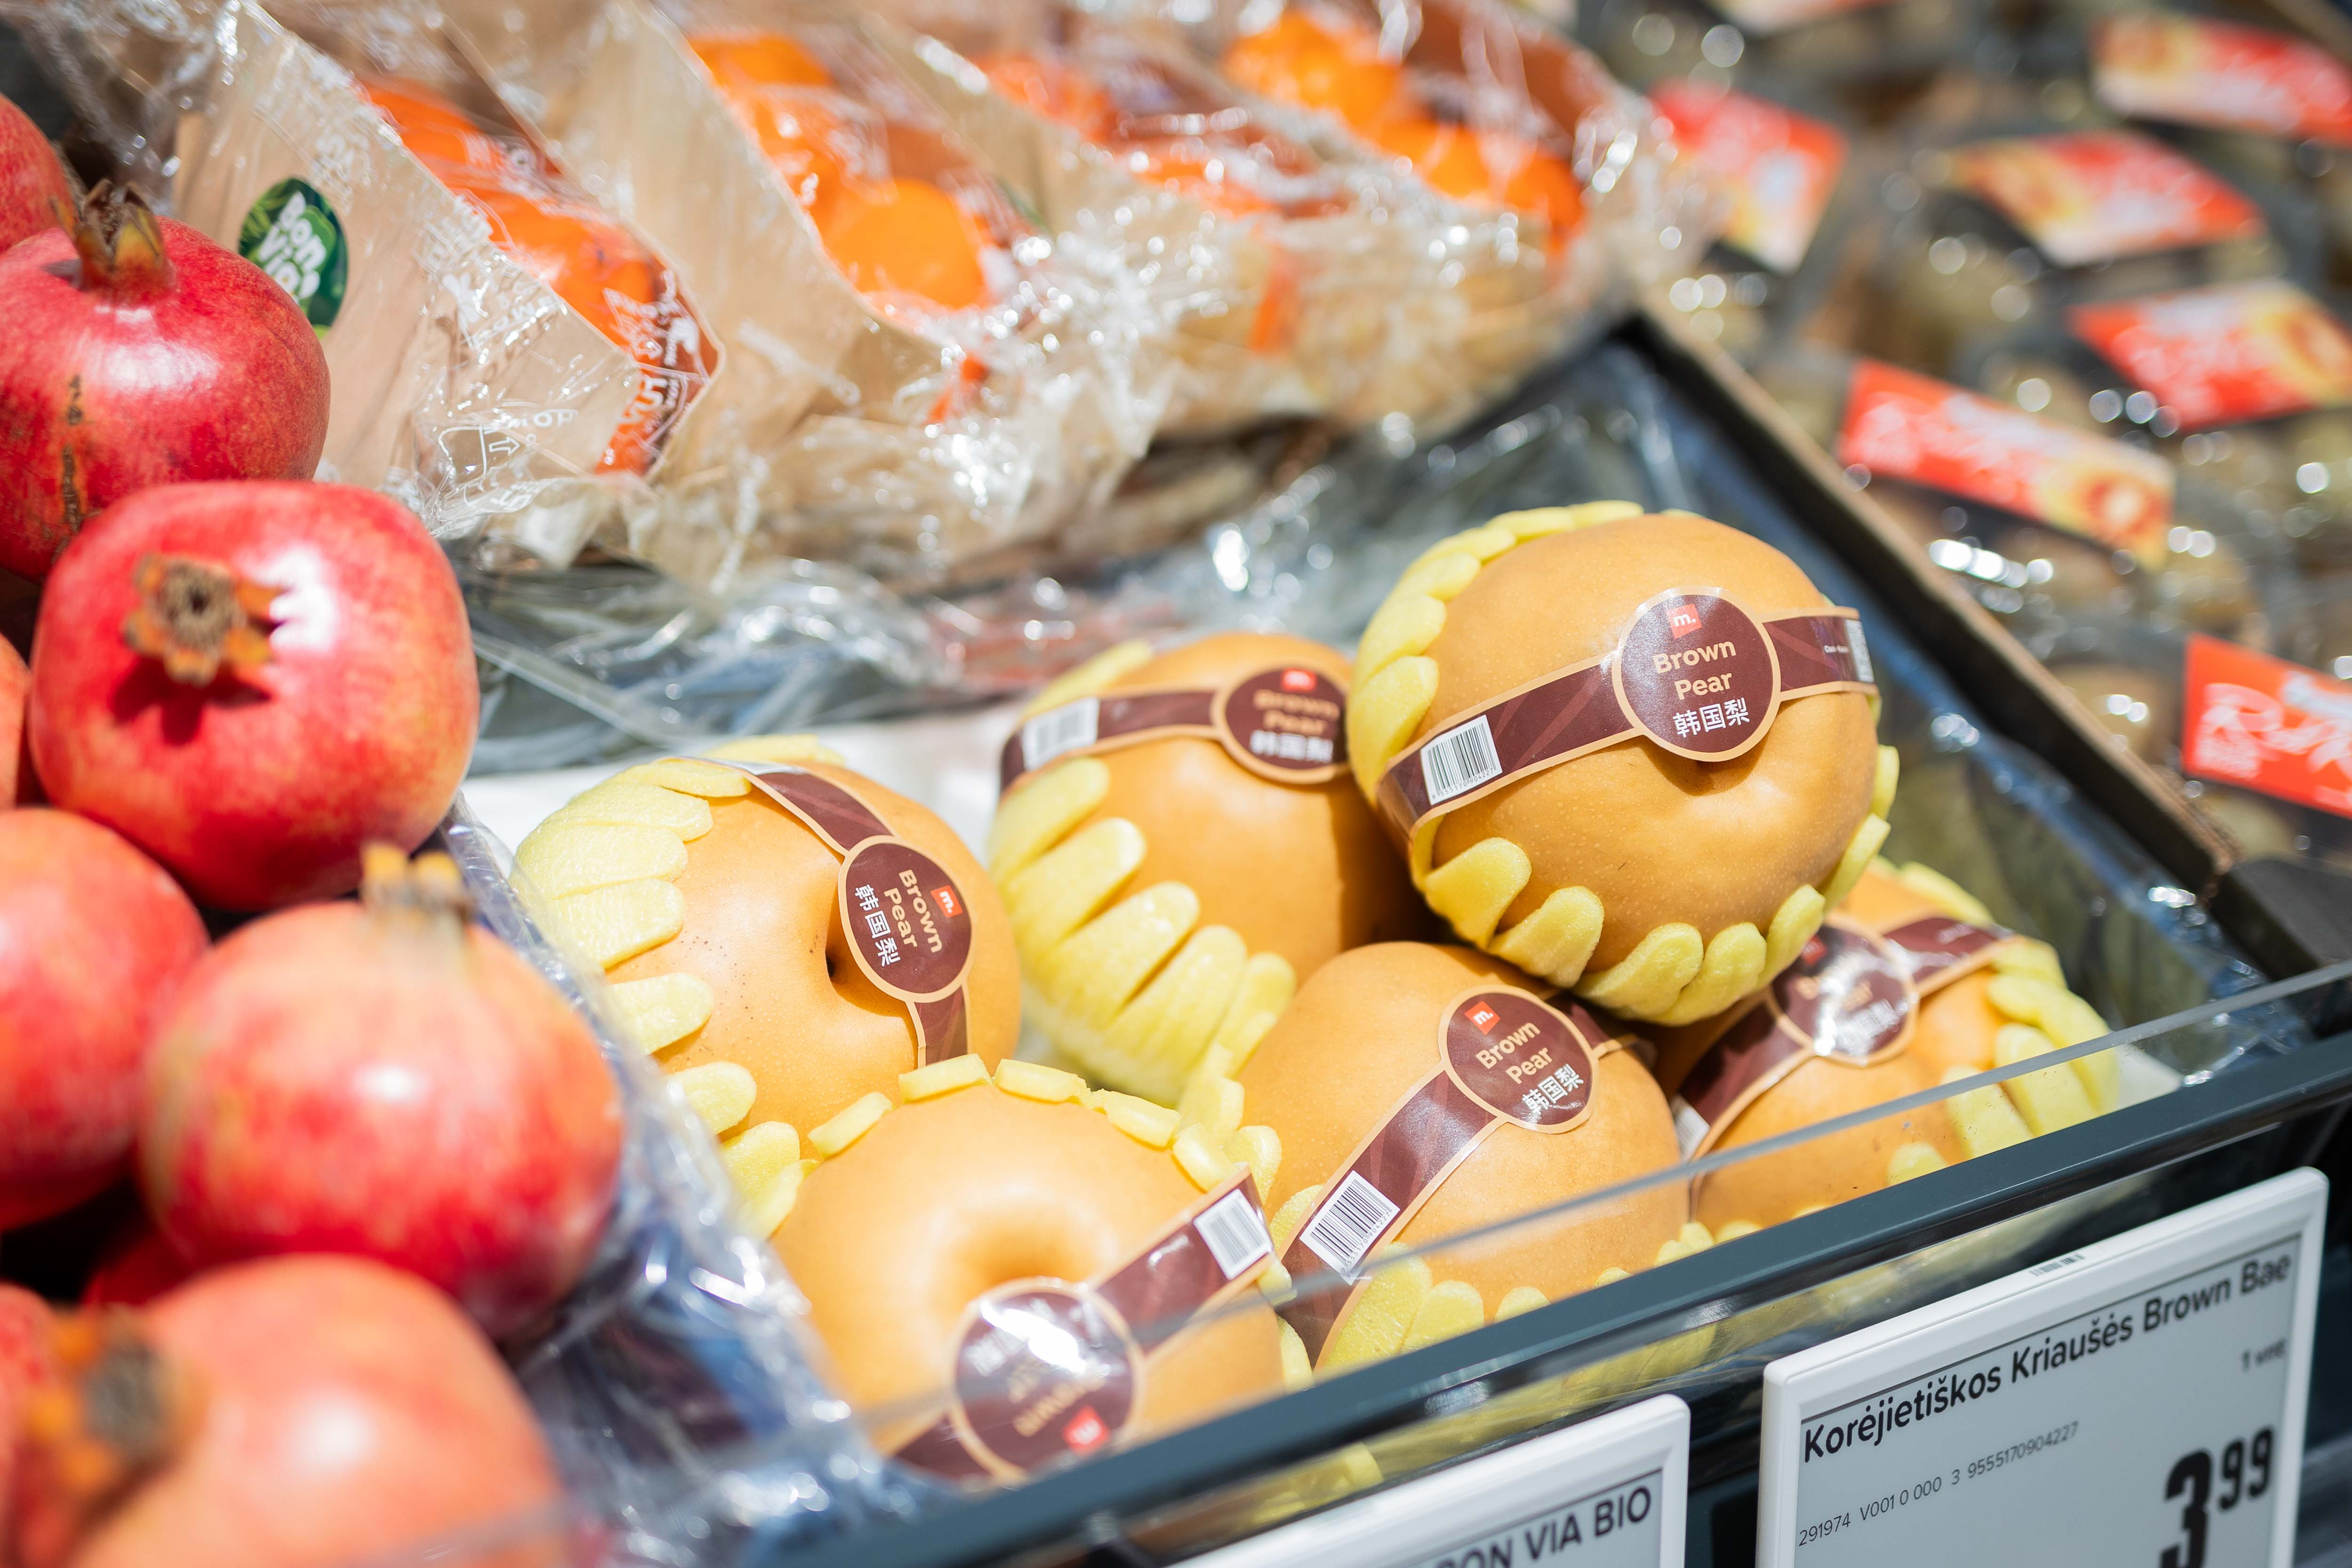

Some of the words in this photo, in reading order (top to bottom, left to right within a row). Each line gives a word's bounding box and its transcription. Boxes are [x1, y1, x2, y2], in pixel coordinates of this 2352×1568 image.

[1653, 641, 1737, 674] Brown
[1675, 673, 1732, 700] Pear
[1673, 697, 1750, 738] 韩国梨
[855, 884, 901, 967] 韩国梨
[884, 888, 917, 947] Pear
[898, 869, 943, 953] Brown
[1476, 1023, 1541, 1069] Brown
[1506, 1047, 1552, 1084] Pear
[1522, 1063, 1584, 1114] 韩国梨
[1805, 1366, 2001, 1463] Korėjietiškos
[2012, 1313, 2133, 1383] Kriaušės
[2143, 1277, 2231, 1332] Brown
[2241, 1255, 2291, 1296] Bae
[1799, 1512, 1851, 1547] 291974
[1951, 1469, 1960, 1485] 3
[1967, 1421, 2079, 1479] 9555170904227
[1435, 1536, 1513, 1568] ON
[1524, 1512, 1582, 1561] VIA
[1595, 1485, 1652, 1537] BIO
